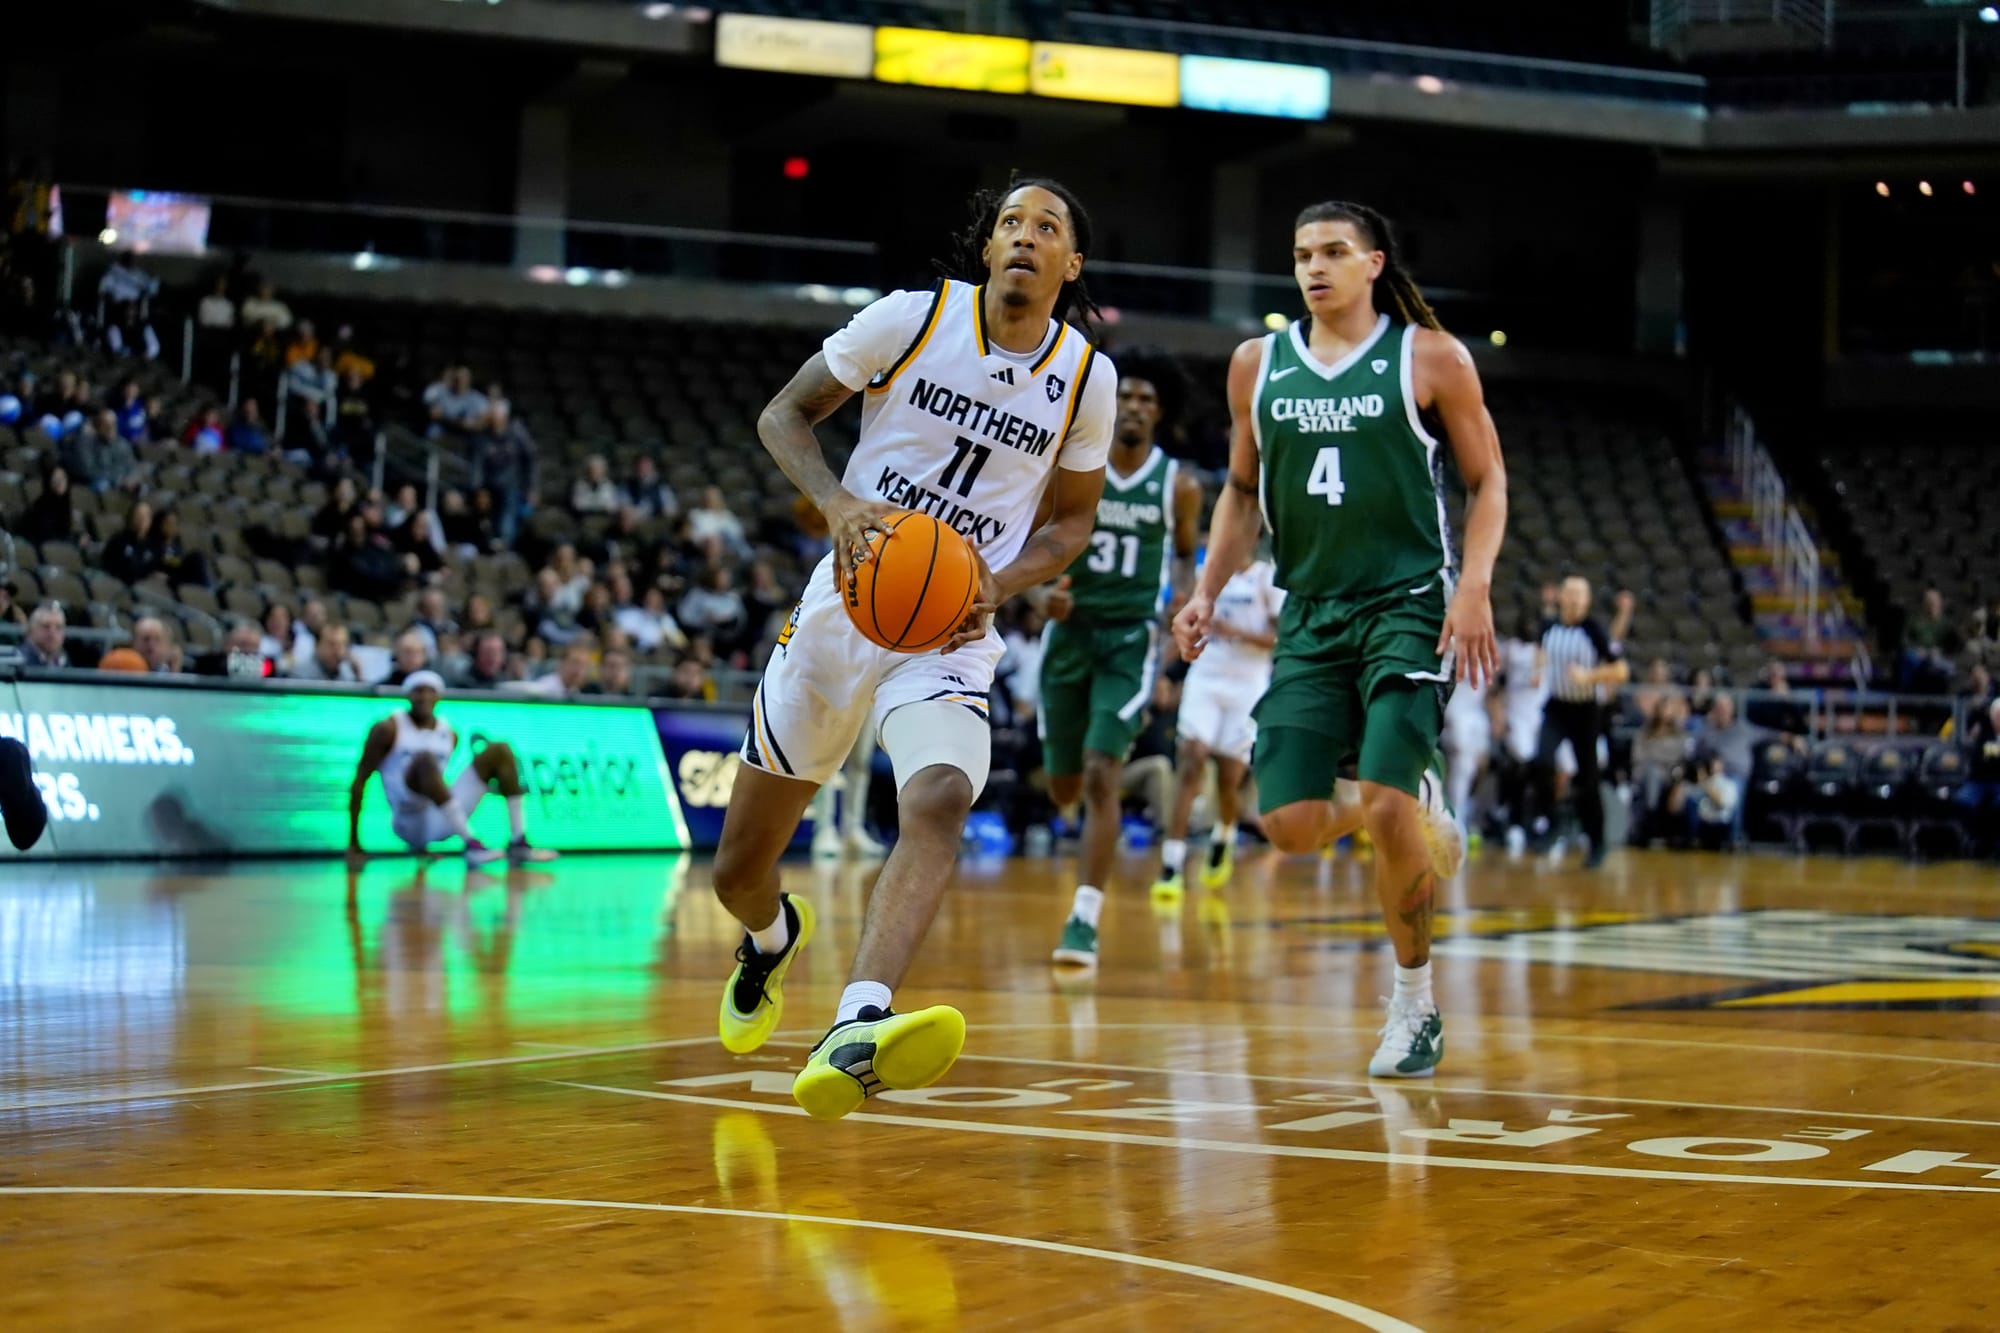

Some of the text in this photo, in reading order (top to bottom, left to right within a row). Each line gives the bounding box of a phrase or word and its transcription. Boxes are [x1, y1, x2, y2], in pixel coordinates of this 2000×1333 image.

[908, 377, 1056, 457] NORTHERN
[1270, 393, 1385, 422] CLEVELAND
[937, 435, 992, 498] 11
[1306, 446, 1346, 506] 4
[875, 466, 1007, 545] KENTUCKY
[1087, 530, 1140, 578] 31
